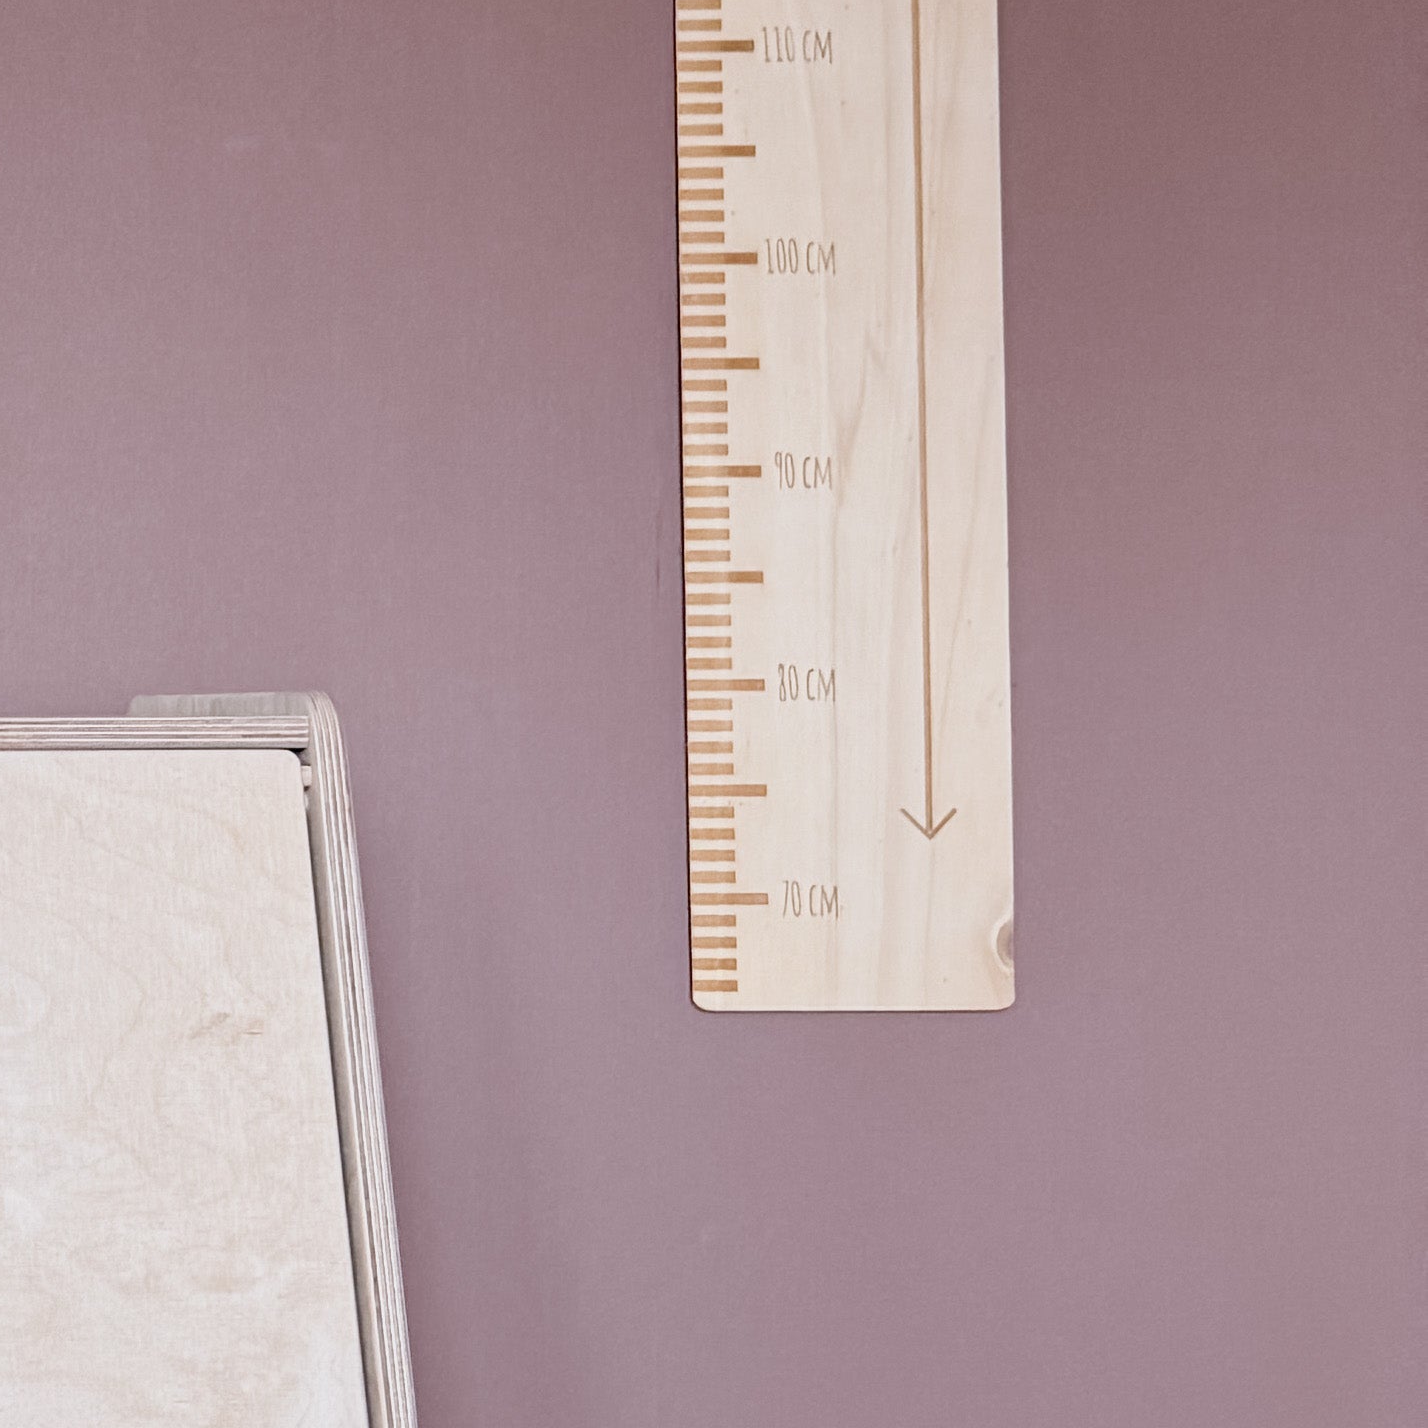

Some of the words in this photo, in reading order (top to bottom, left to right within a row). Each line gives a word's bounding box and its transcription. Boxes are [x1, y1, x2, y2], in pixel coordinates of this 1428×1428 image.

[762, 25, 795, 63] 110
[802, 29, 833, 64] CM
[765, 237, 799, 275] 100
[807, 240, 837, 276] CM
[774, 451, 796, 490] 90
[802, 456, 833, 490] CM
[777, 663, 799, 702] 80
[806, 668, 837, 703] CM
[782, 880, 802, 918] 70
[809, 884, 839, 921] CM
